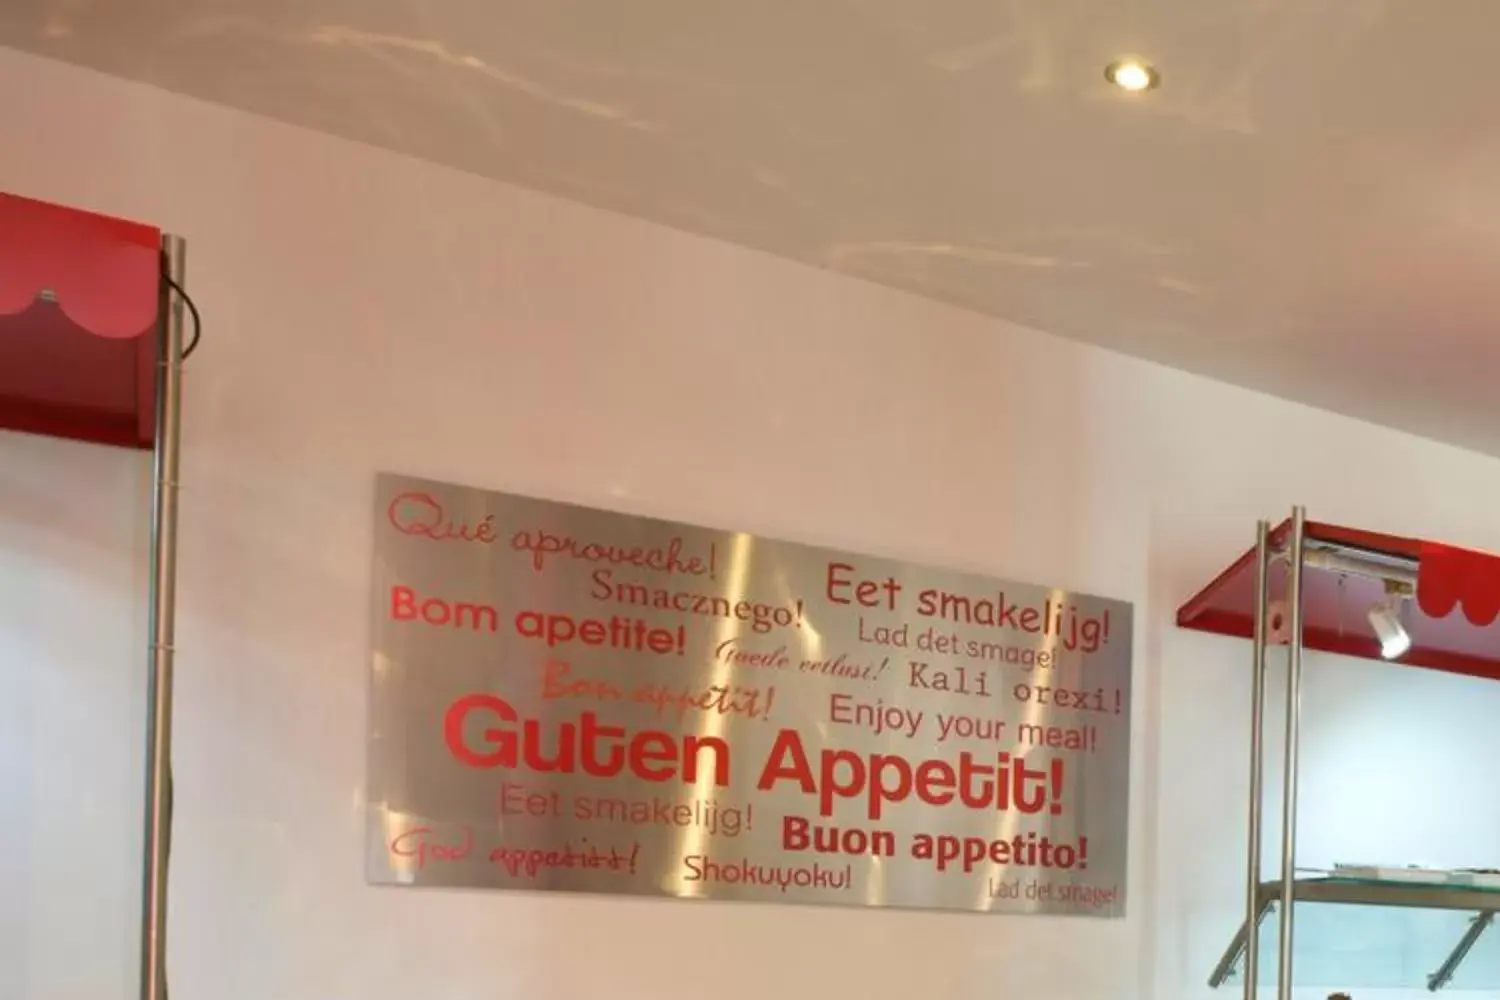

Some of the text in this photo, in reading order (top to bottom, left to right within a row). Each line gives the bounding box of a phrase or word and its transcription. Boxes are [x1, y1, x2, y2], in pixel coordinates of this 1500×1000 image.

[389, 492, 716, 578] Qué aproveche!
[390, 586, 684, 655] Bom apetite!
[589, 569, 803, 633] Smacznego!
[827, 563, 1111, 652] Eet smakelijg!
[858, 618, 1058, 668] Lad det smage!
[909, 662, 1121, 713] Kali orexi!
[830, 694, 1096, 752] Enjoy your meal!
[444, 692, 1064, 819] Guten Appetit!
[501, 782, 753, 836] Eet smakelijg!
[783, 816, 1088, 871] Buon appetito!
[684, 855, 851, 891] Shokuyoku!
